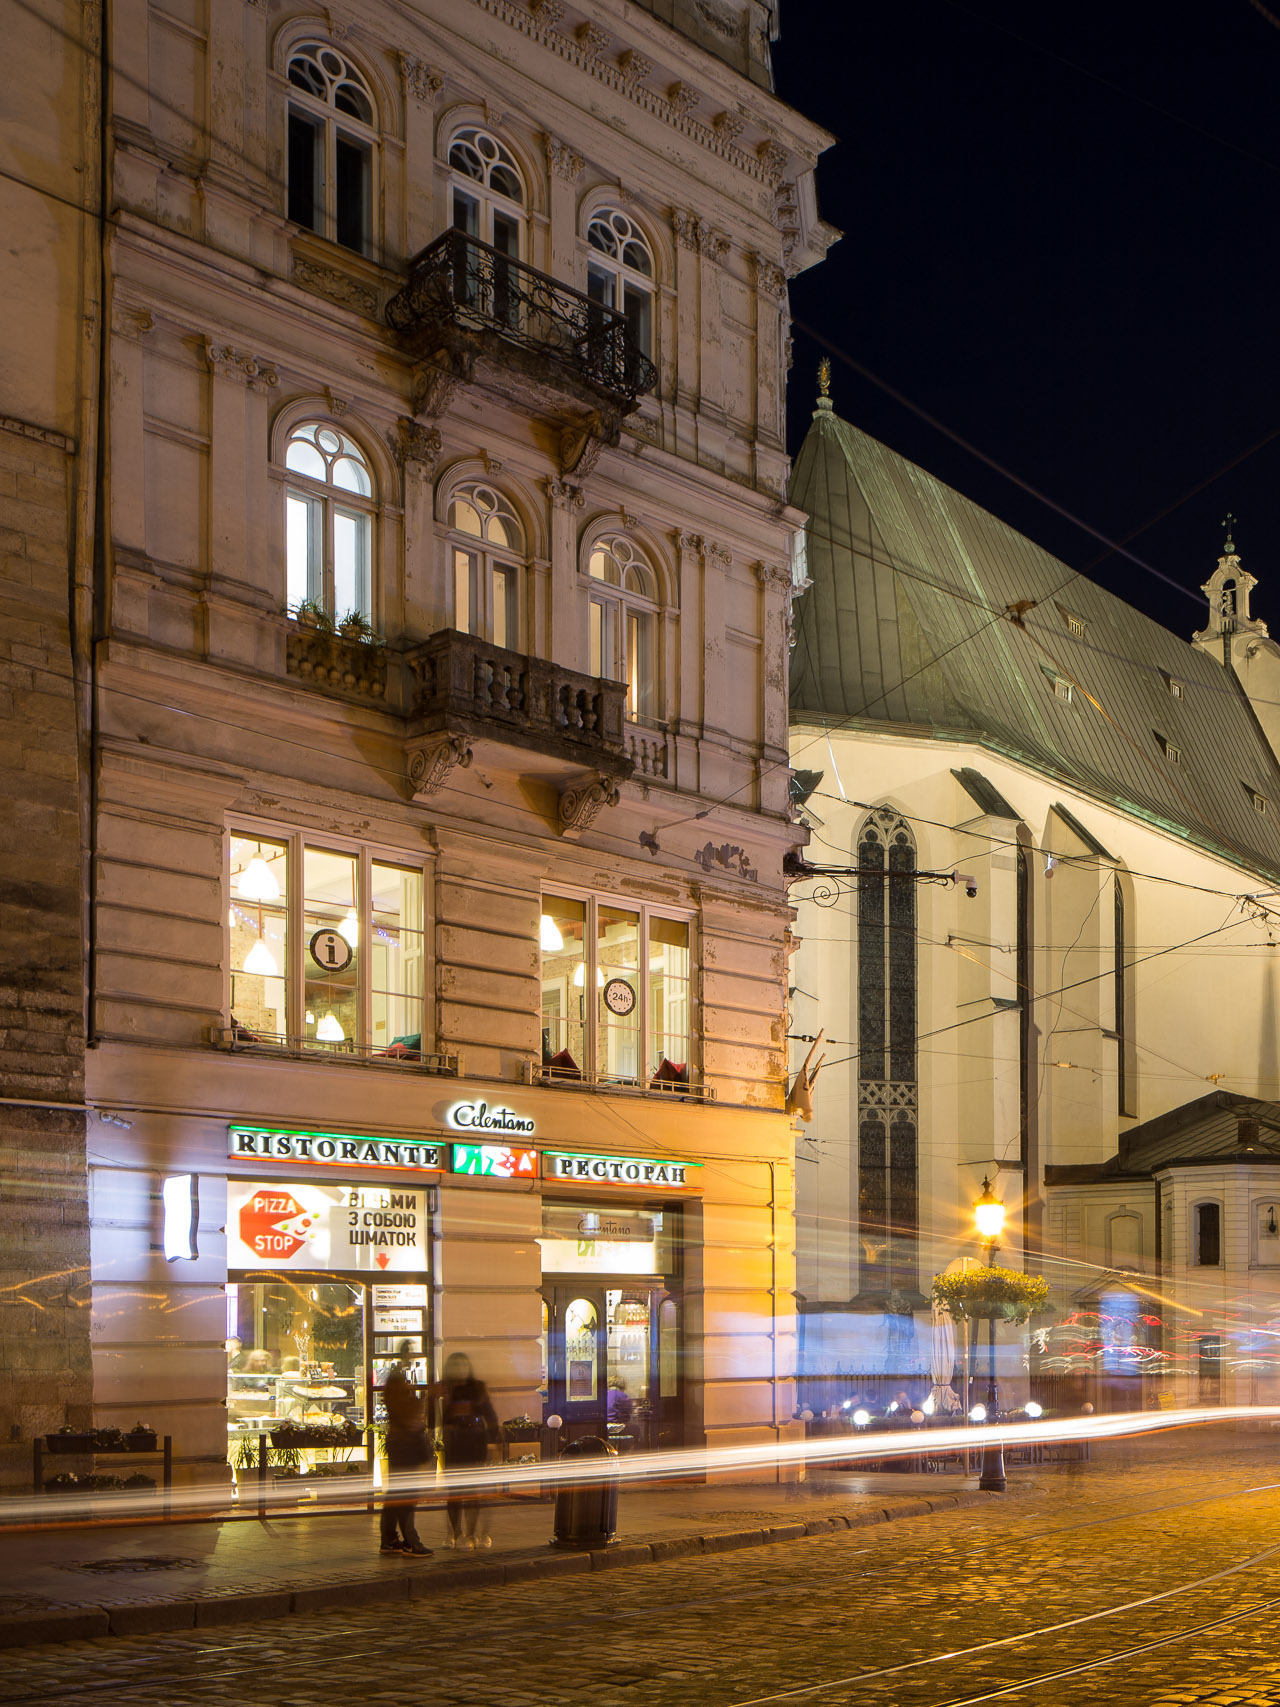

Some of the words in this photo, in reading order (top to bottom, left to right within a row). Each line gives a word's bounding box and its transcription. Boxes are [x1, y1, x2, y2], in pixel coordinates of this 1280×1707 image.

[612, 992, 629, 1003] 24h
[453, 1103, 535, 1132] Celentano
[236, 1134, 439, 1165] RISTORANTE
[559, 1159, 686, 1183] РЕСТОРАН
[254, 1197, 297, 1214] PIZZA
[348, 1192, 416, 1210] ВІЬМИ
[363, 1212, 416, 1228] СОБОЮ
[255, 1235, 294, 1251] STOP
[349, 1230, 416, 1247] ШМАТОК
